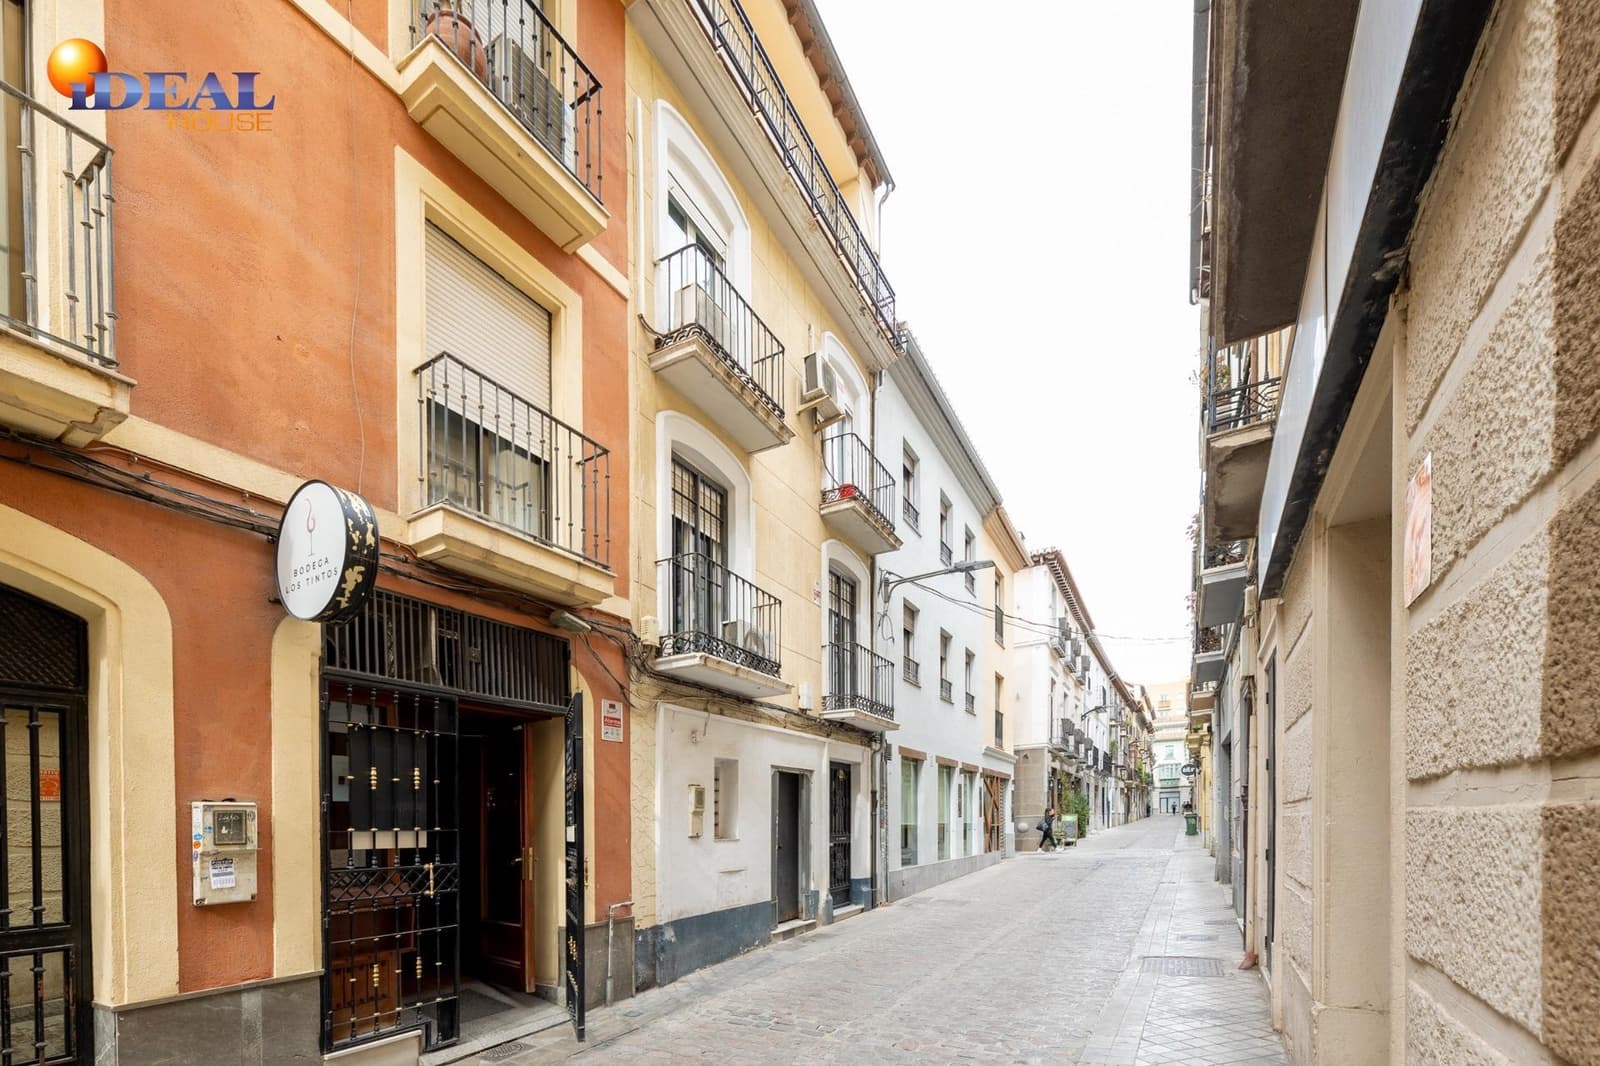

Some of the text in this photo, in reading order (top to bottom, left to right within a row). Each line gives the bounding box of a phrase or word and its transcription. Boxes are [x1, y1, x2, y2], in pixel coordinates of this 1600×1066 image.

[293, 556, 329, 577] BODEGA
[285, 567, 338, 595] LOS TINTOS
